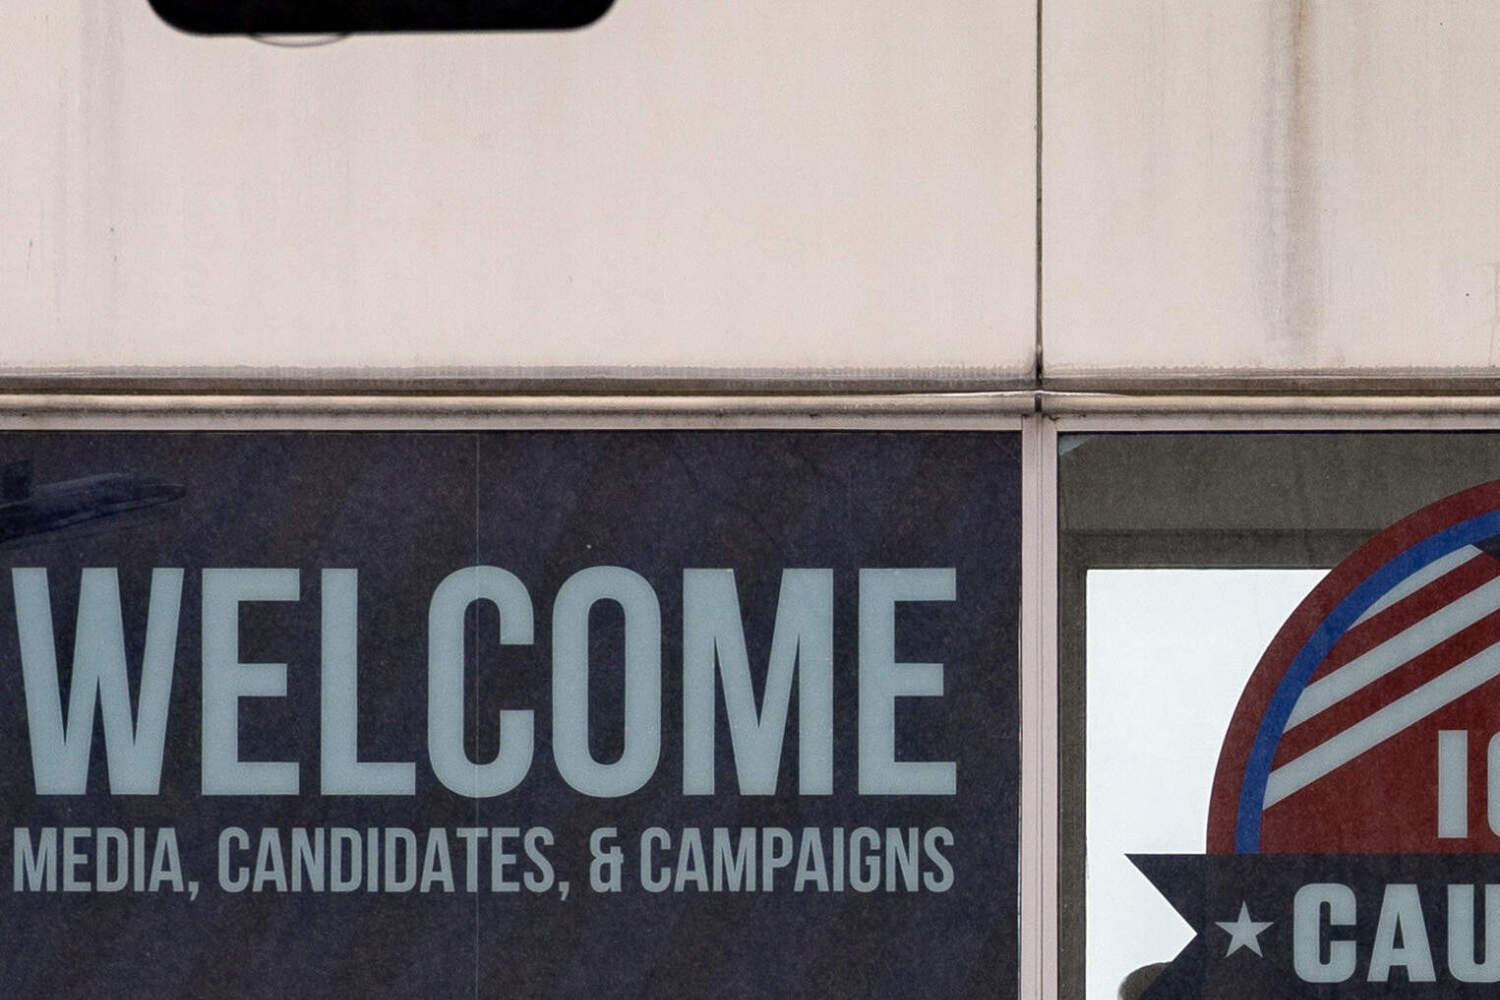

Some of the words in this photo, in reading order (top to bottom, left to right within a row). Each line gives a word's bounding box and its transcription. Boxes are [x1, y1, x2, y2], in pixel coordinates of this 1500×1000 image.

[11, 565, 957, 799] WELCOME
[12, 826, 201, 903] MEDIA,
[217, 826, 570, 903] CANDIDATES,
[588, 826, 624, 894] &
[639, 826, 956, 894] CAMPAIGNS
